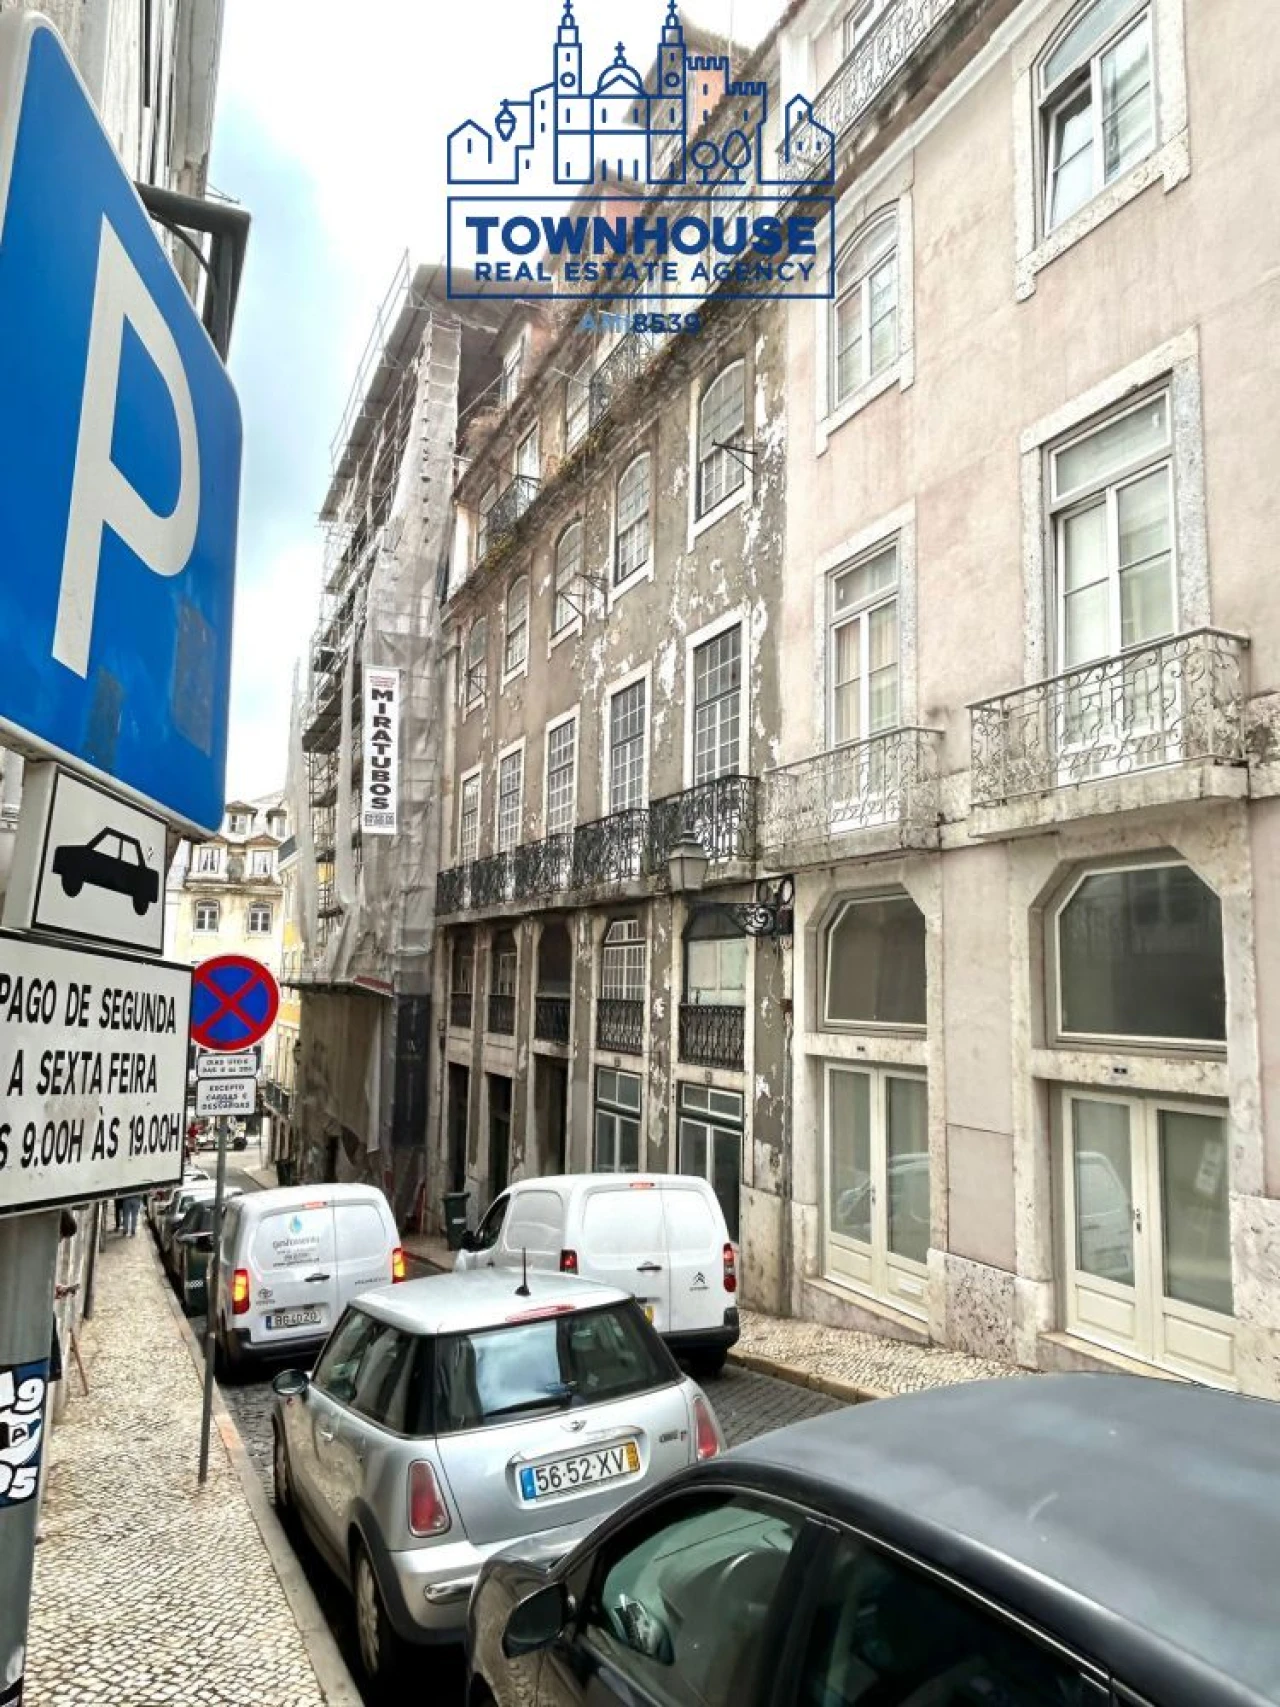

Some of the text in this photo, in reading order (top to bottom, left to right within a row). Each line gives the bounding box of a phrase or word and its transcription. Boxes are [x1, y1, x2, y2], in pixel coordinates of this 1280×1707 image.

[52, 212, 200, 679] P
[369, 688, 394, 810] MIRATUBOS
[65, 982, 91, 1027] DE
[99, 988, 176, 1033] SEGUNDA
[7, 1050, 157, 1096] A SEXTA FEIRA
[21, 1118, 84, 1168] 9.00H
[92, 1106, 120, 1161] ÀS
[129, 1113, 181, 1156] 19.00H
